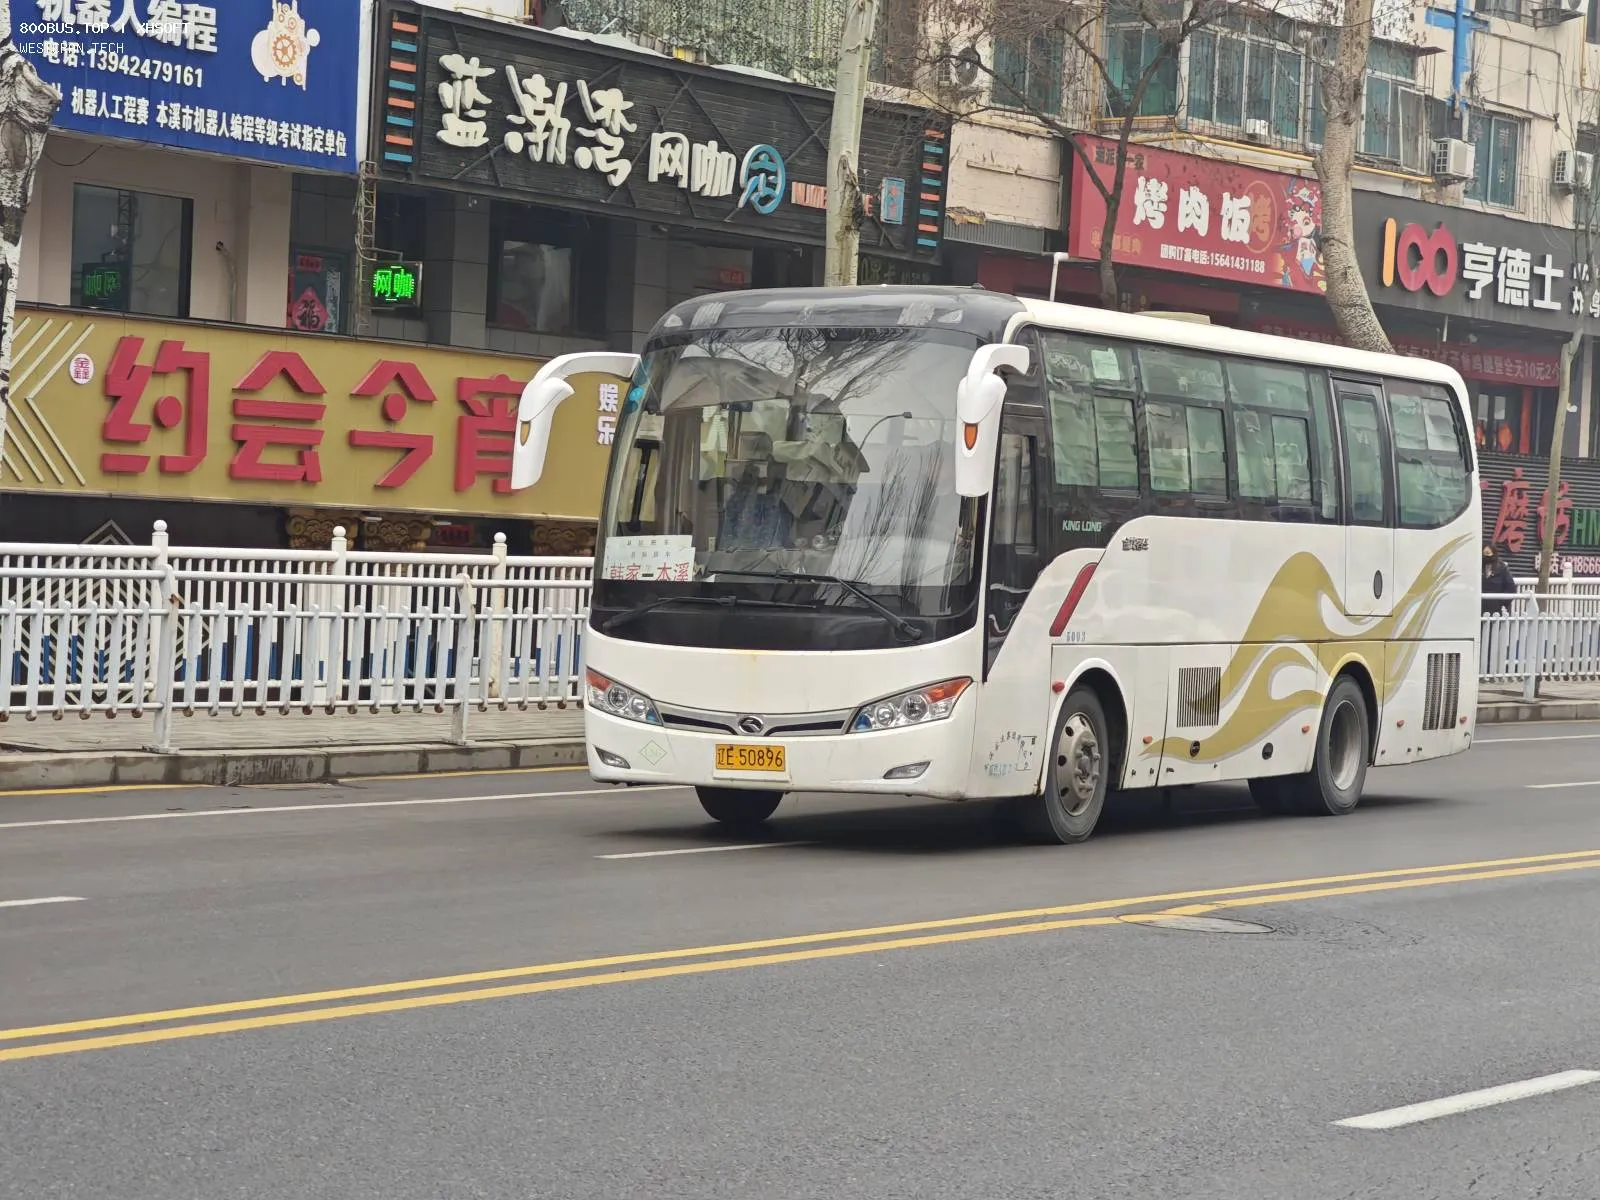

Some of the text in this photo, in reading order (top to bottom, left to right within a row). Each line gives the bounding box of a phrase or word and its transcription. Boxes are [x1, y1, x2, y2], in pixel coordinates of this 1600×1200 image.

[648, 131, 737, 197] 网咖
[1133, 175, 1252, 245] 烤肉饭
[373, 268, 415, 299] 网咖
[1462, 242, 1564, 311] 亨德士
[1062, 520, 1102, 532] KING LONG
